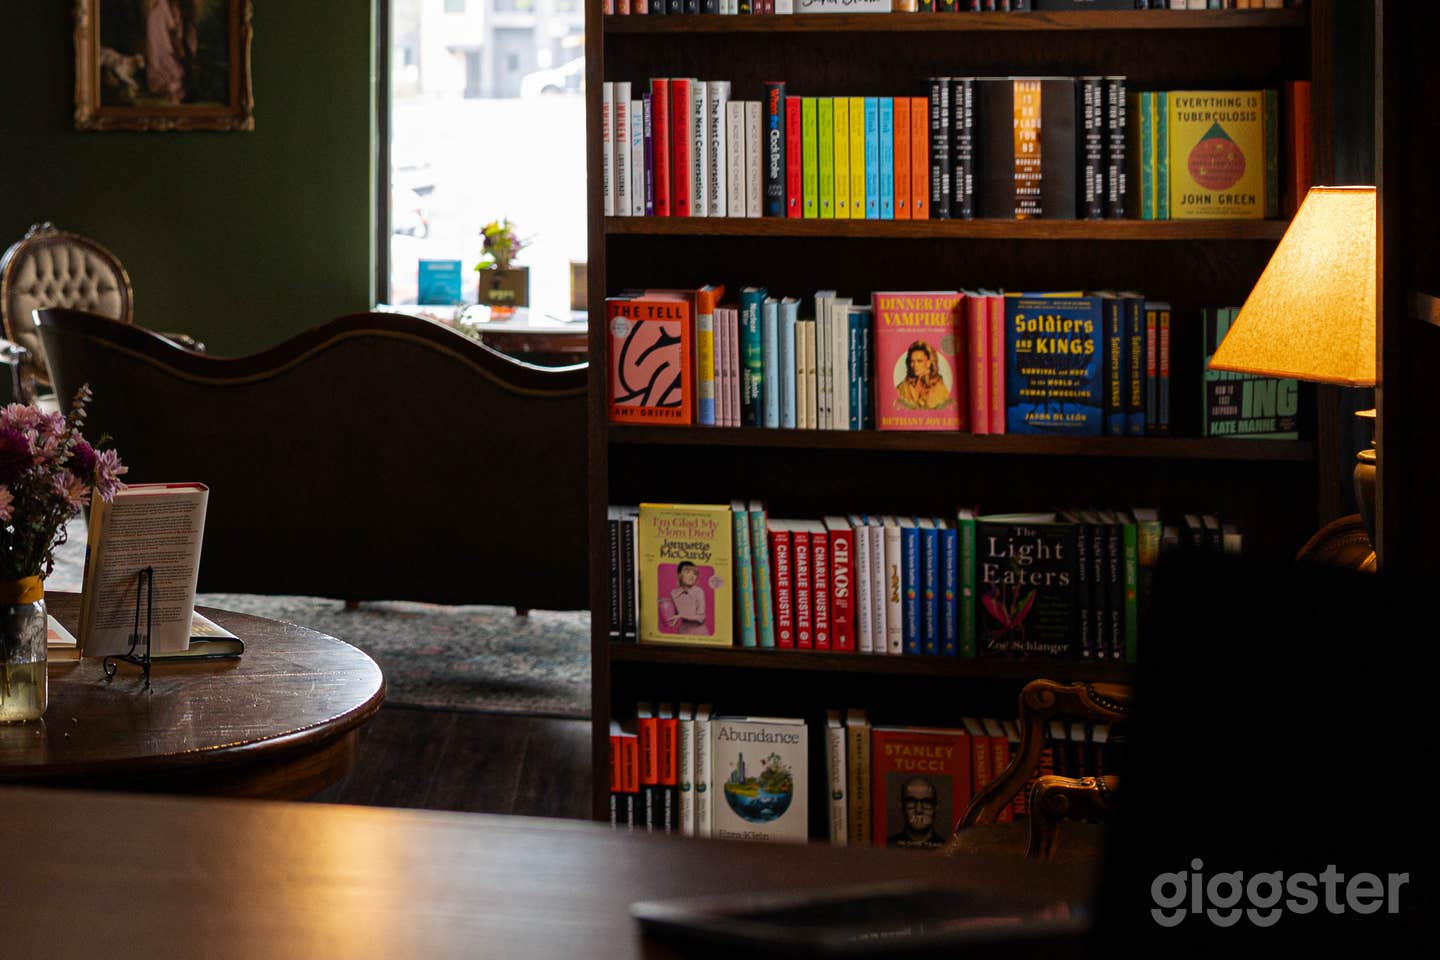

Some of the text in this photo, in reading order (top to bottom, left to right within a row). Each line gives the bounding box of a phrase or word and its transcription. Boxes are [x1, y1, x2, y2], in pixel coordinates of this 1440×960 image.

[1176, 97, 1257, 108] EVERYTHING IS
[616, 103, 627, 143] IMMINENT
[1014, 119, 1041, 129] PLACE
[1177, 112, 1257, 122] TUBERCULOSIS
[633, 114, 641, 145] PEAK
[1020, 130, 1037, 141] FOR
[770, 129, 780, 153] Clock
[1022, 142, 1034, 153] US
[695, 99, 703, 200] The Next Conversation
[711, 99, 720, 200] The Next Conversation
[770, 154, 780, 179] Broke
[1181, 194, 1256, 205] JOHN GREEN
[613, 305, 683, 319] THE TELL
[880, 298, 932, 310] DINNER
[1015, 313, 1094, 333] Soldiers
[1036, 338, 1094, 355] KINGS
[1210, 421, 1237, 435] KATE
[1238, 419, 1277, 433] MANNE
[672, 517, 699, 528] Glad
[701, 519, 719, 529] My
[658, 527, 715, 539] Mom Died
[1016, 527, 1037, 537] The
[663, 539, 710, 550] Jennette
[988, 537, 1064, 566] Light
[660, 548, 712, 562] McCurdy
[834, 538, 848, 598] CHAOS
[982, 563, 1070, 587] Eaters
[778, 545, 790, 626] CHARLIE HUSTLE
[797, 546, 808, 627] CHARLIE HUSTLE
[815, 546, 826, 629] CHARLIE HUSTLE
[1011, 640, 1070, 655] Schlanger
[717, 726, 800, 745] Abundance
[832, 734, 841, 783] Abundance
[885, 744, 953, 757] STANLEY
[893, 758, 944, 771] TUCCI
